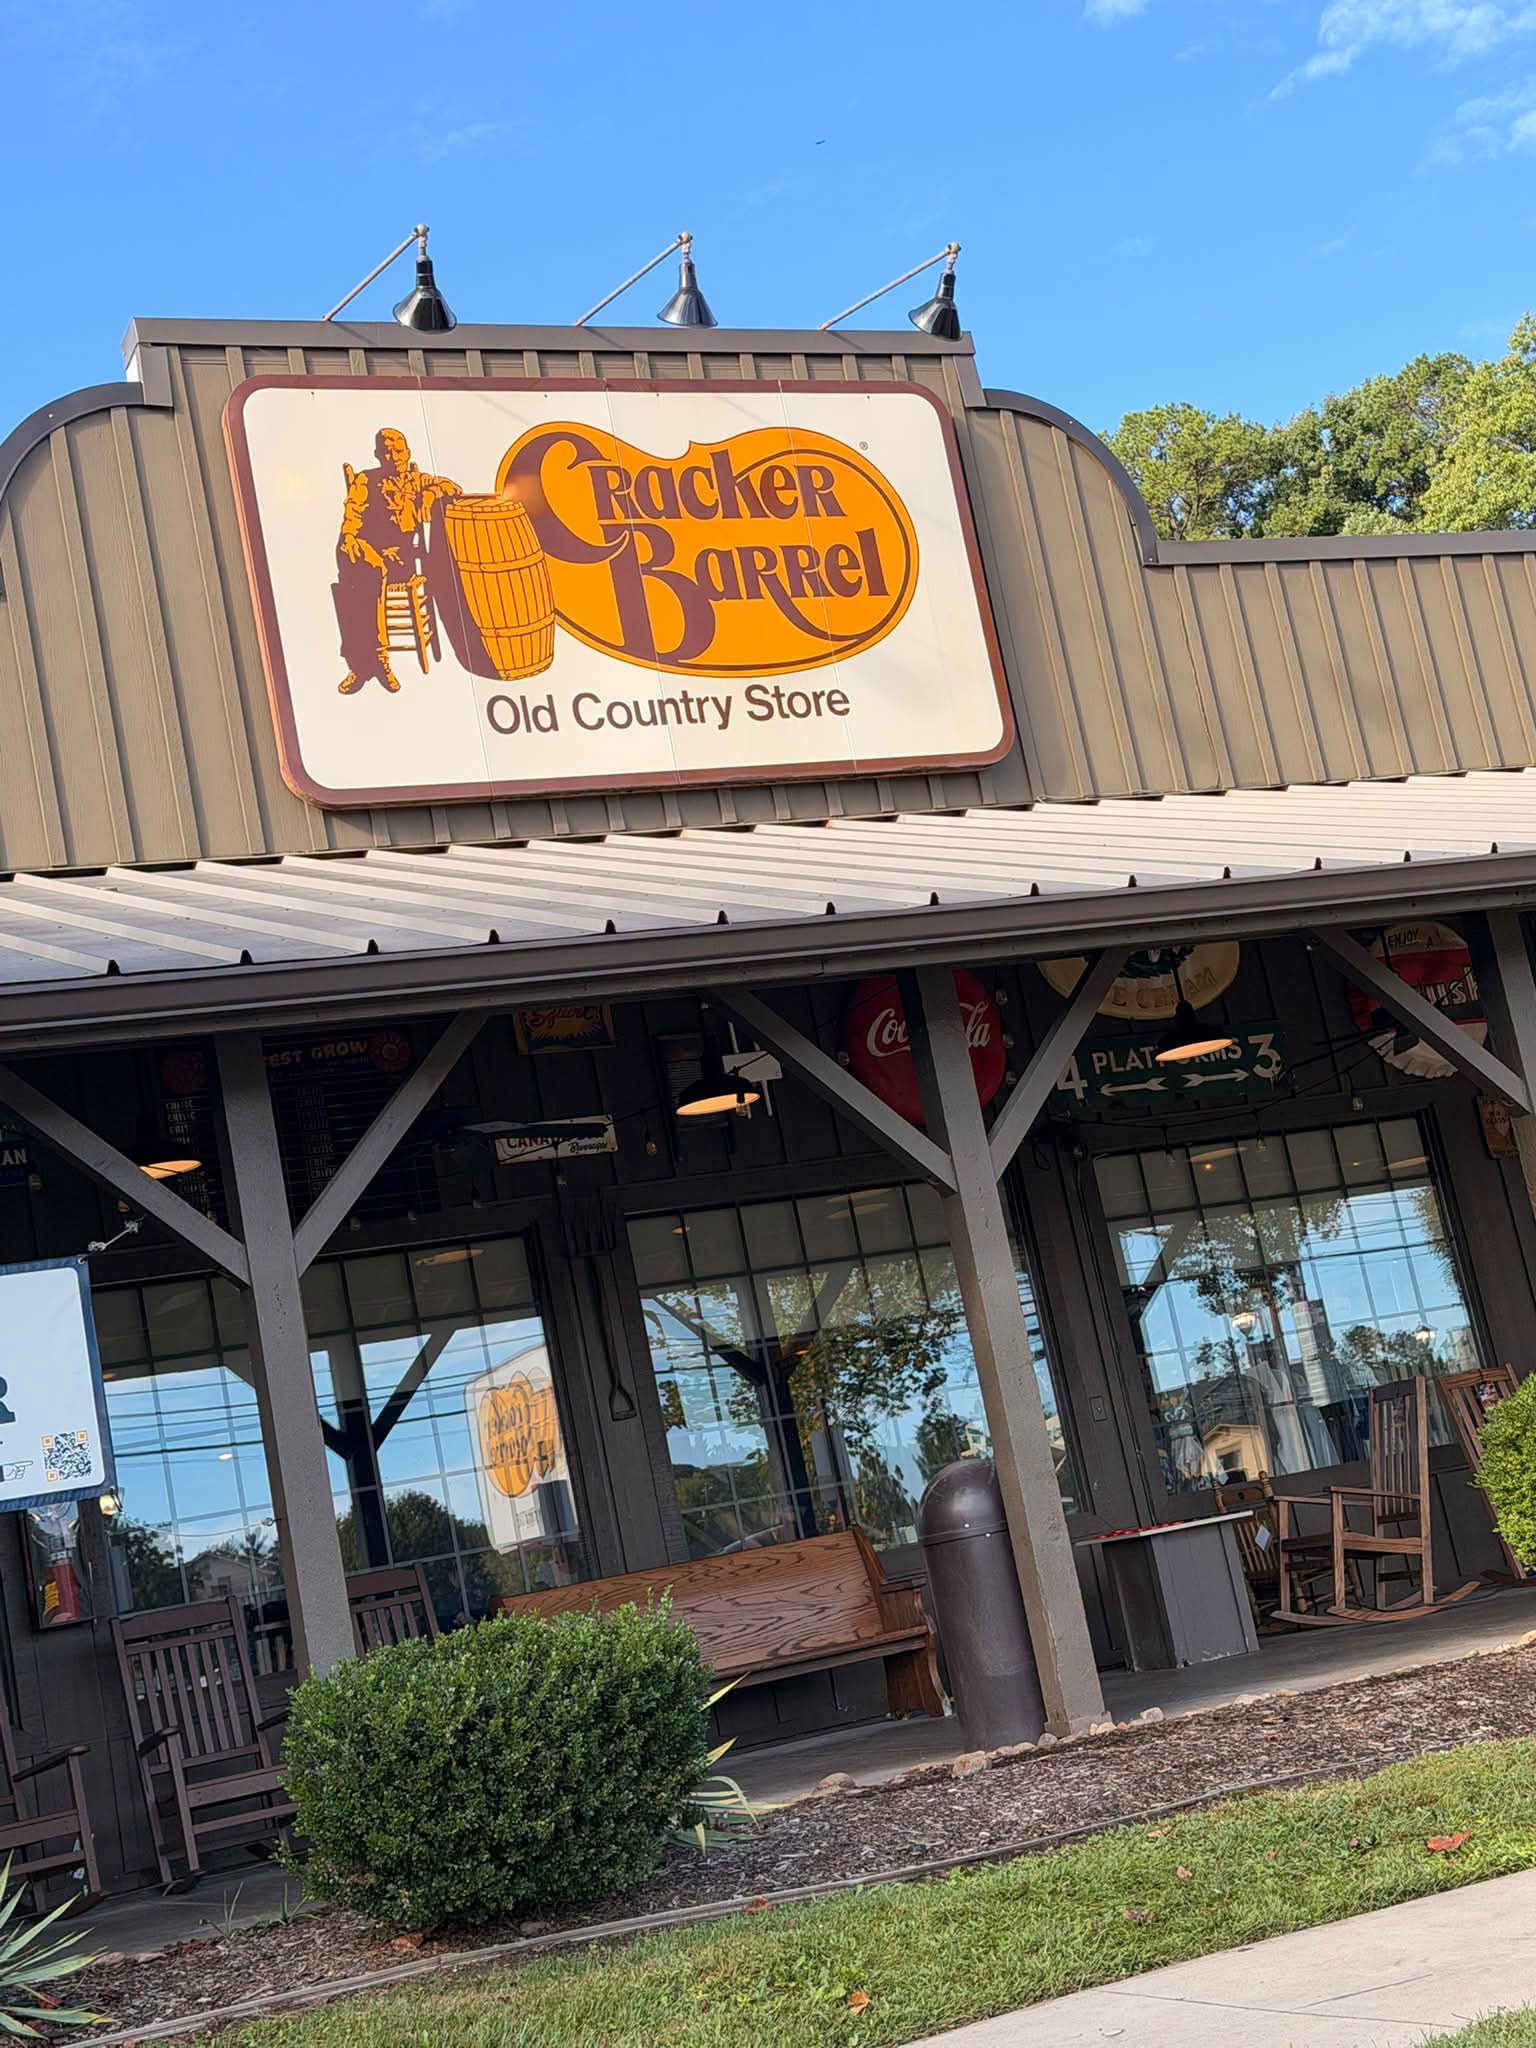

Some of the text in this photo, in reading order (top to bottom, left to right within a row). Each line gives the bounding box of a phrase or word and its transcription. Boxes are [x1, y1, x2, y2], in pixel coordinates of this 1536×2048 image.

[504, 431, 847, 565] Cracker
[602, 522, 889, 666] Barrel
[486, 684, 851, 735] Old Country Store
[1387, 929, 1420, 949] ENJOY
[1056, 1056, 1088, 1101] 4
[1248, 1033, 1281, 1079] 3
